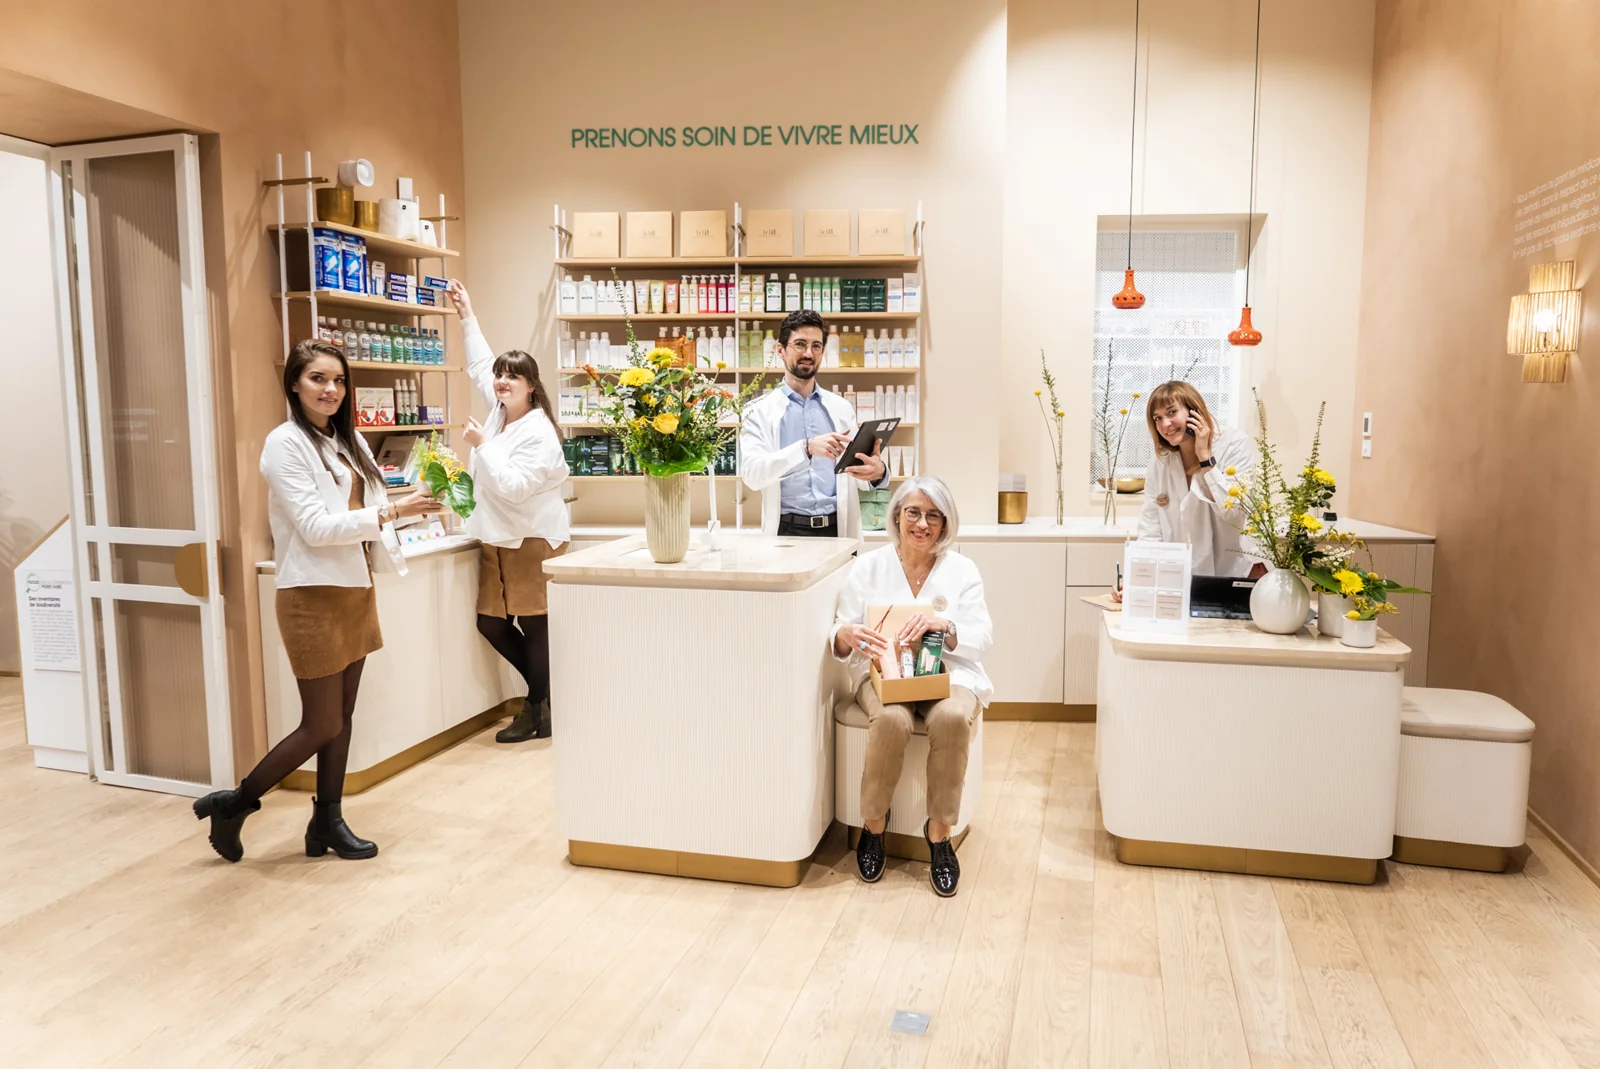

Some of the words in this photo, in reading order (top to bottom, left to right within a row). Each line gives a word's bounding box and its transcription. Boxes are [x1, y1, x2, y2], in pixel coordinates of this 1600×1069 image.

[571, 127, 676, 149] PRENONS
[683, 126, 736, 147] SOIN
[743, 126, 772, 146] DE
[778, 125, 842, 146] VIVRE
[850, 124, 919, 145] MIEUX
